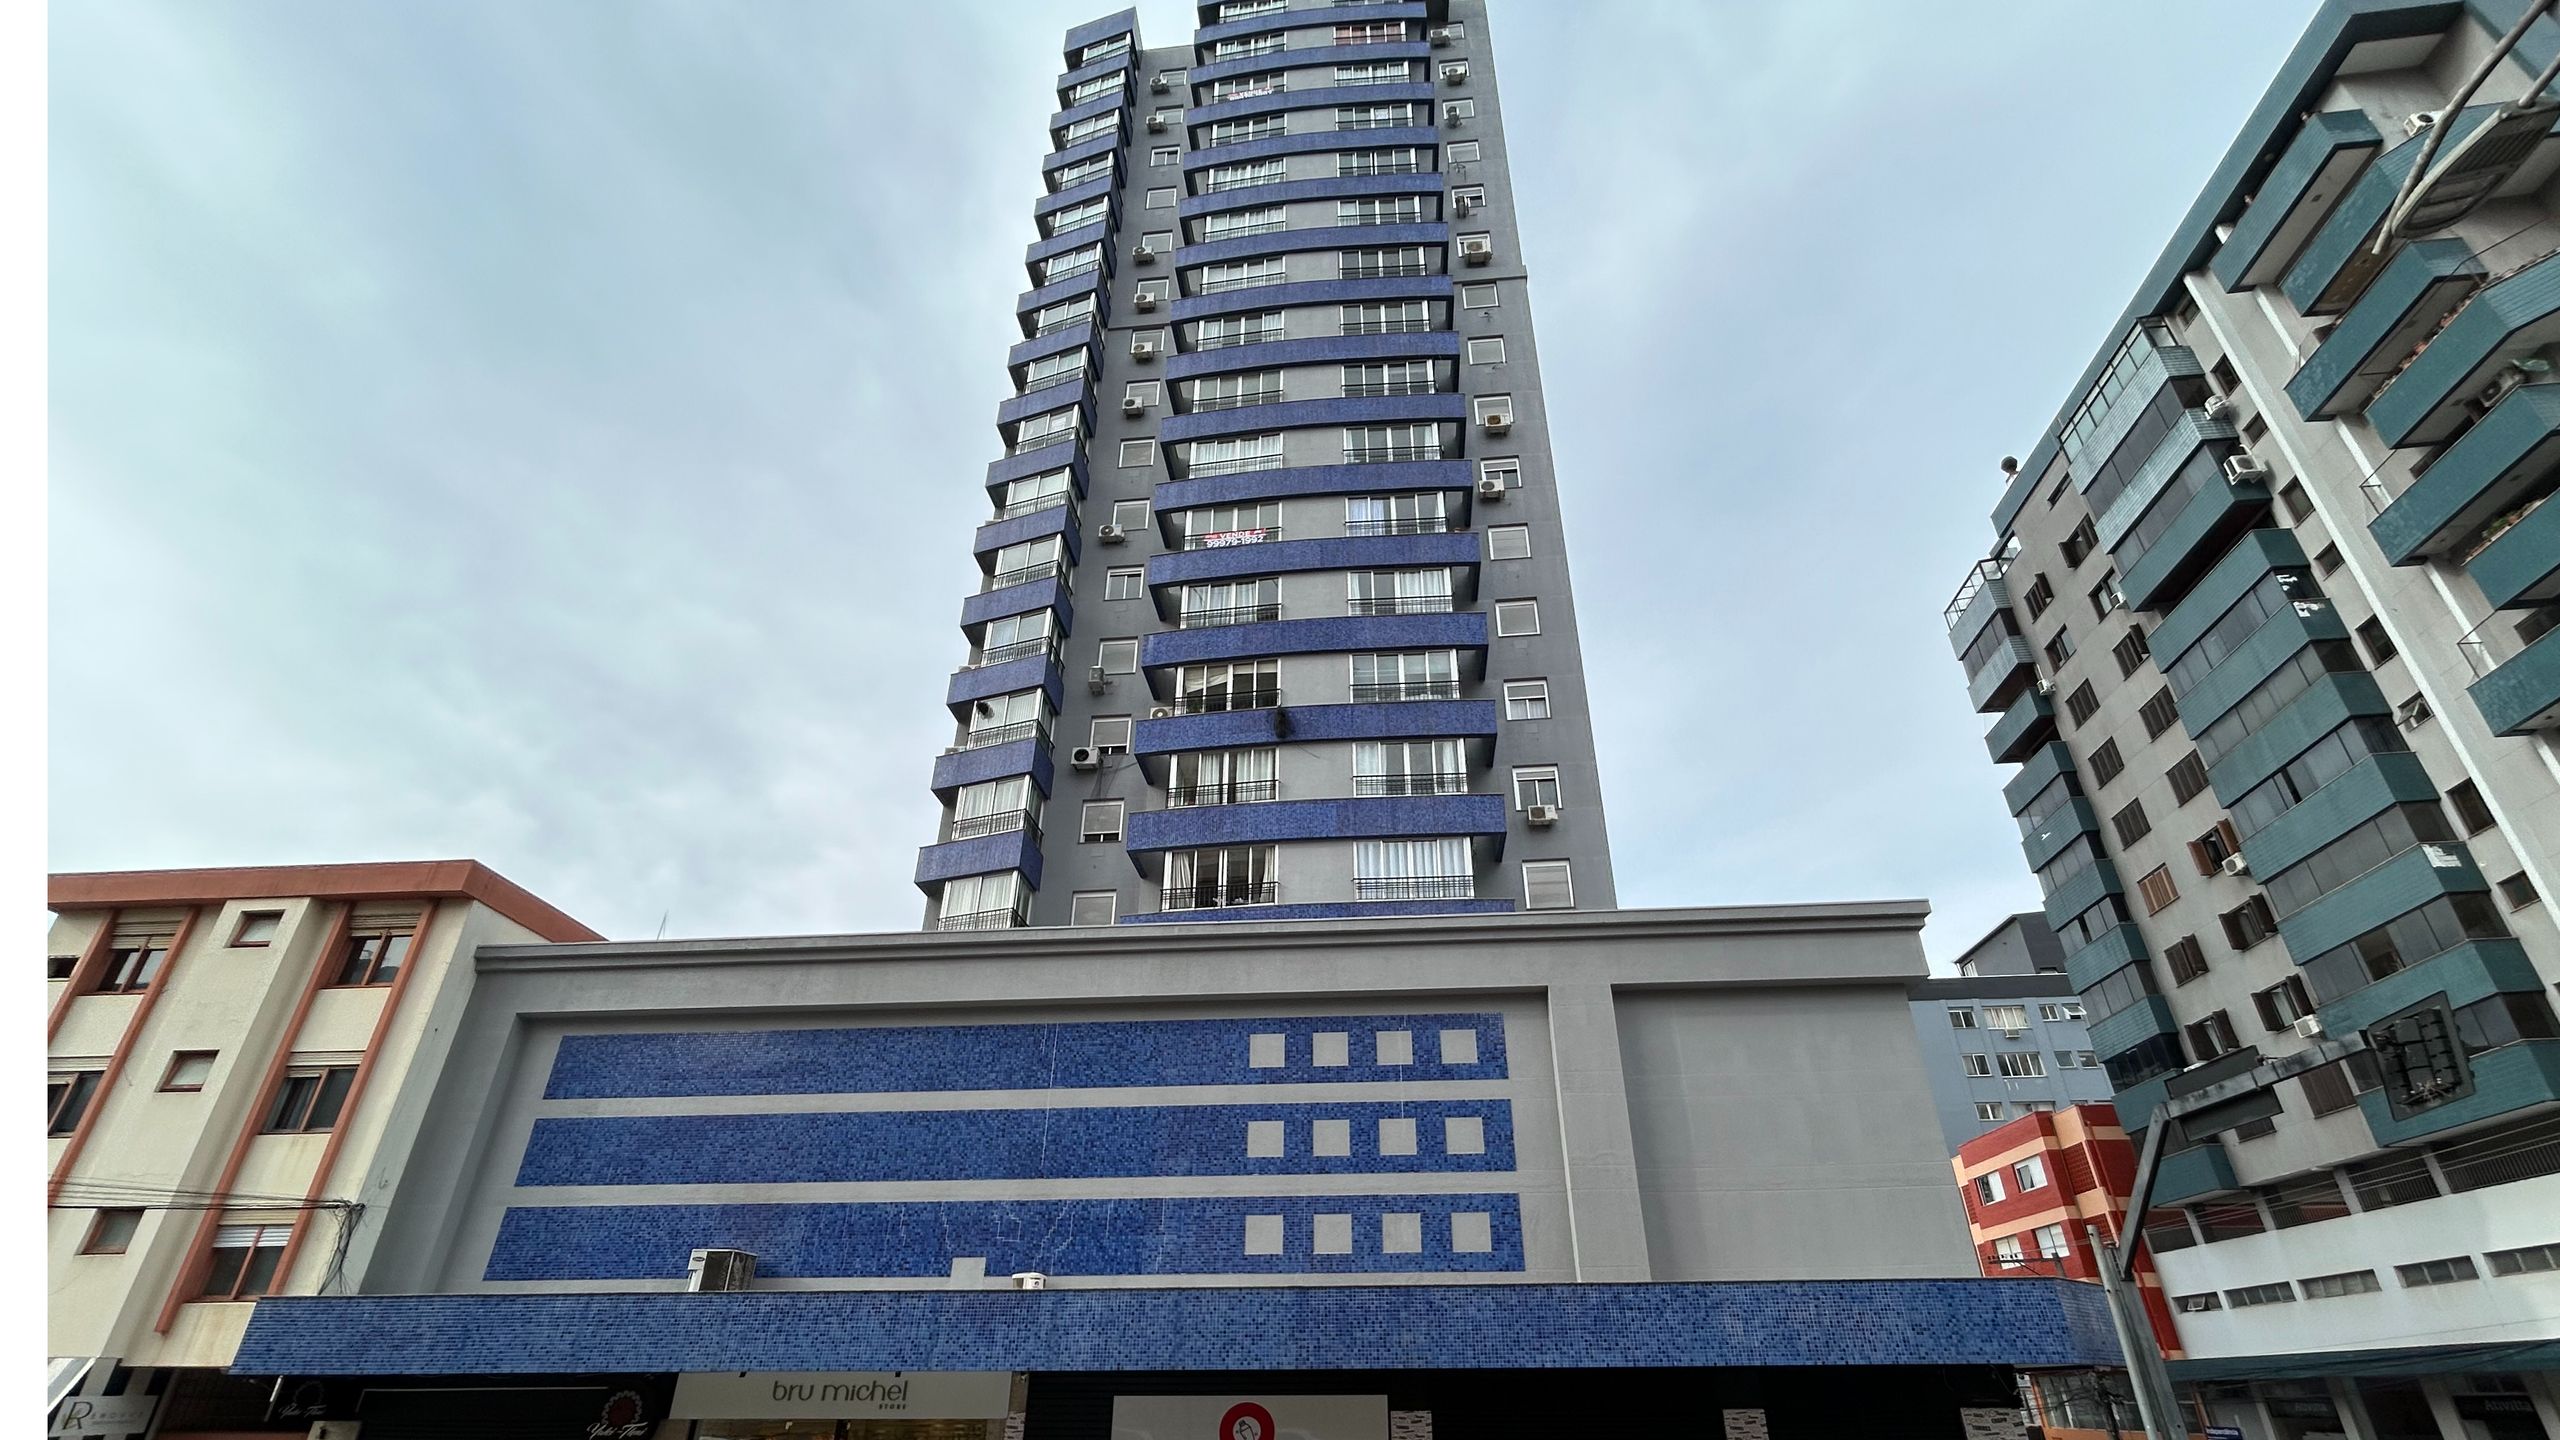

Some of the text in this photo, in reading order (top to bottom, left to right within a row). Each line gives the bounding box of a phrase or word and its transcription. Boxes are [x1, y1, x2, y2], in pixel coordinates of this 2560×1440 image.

[1220, 530, 1250, 539] VENDE
[1206, 535, 1264, 548] 99979-1992
[772, 1380, 909, 1402] bru michel
